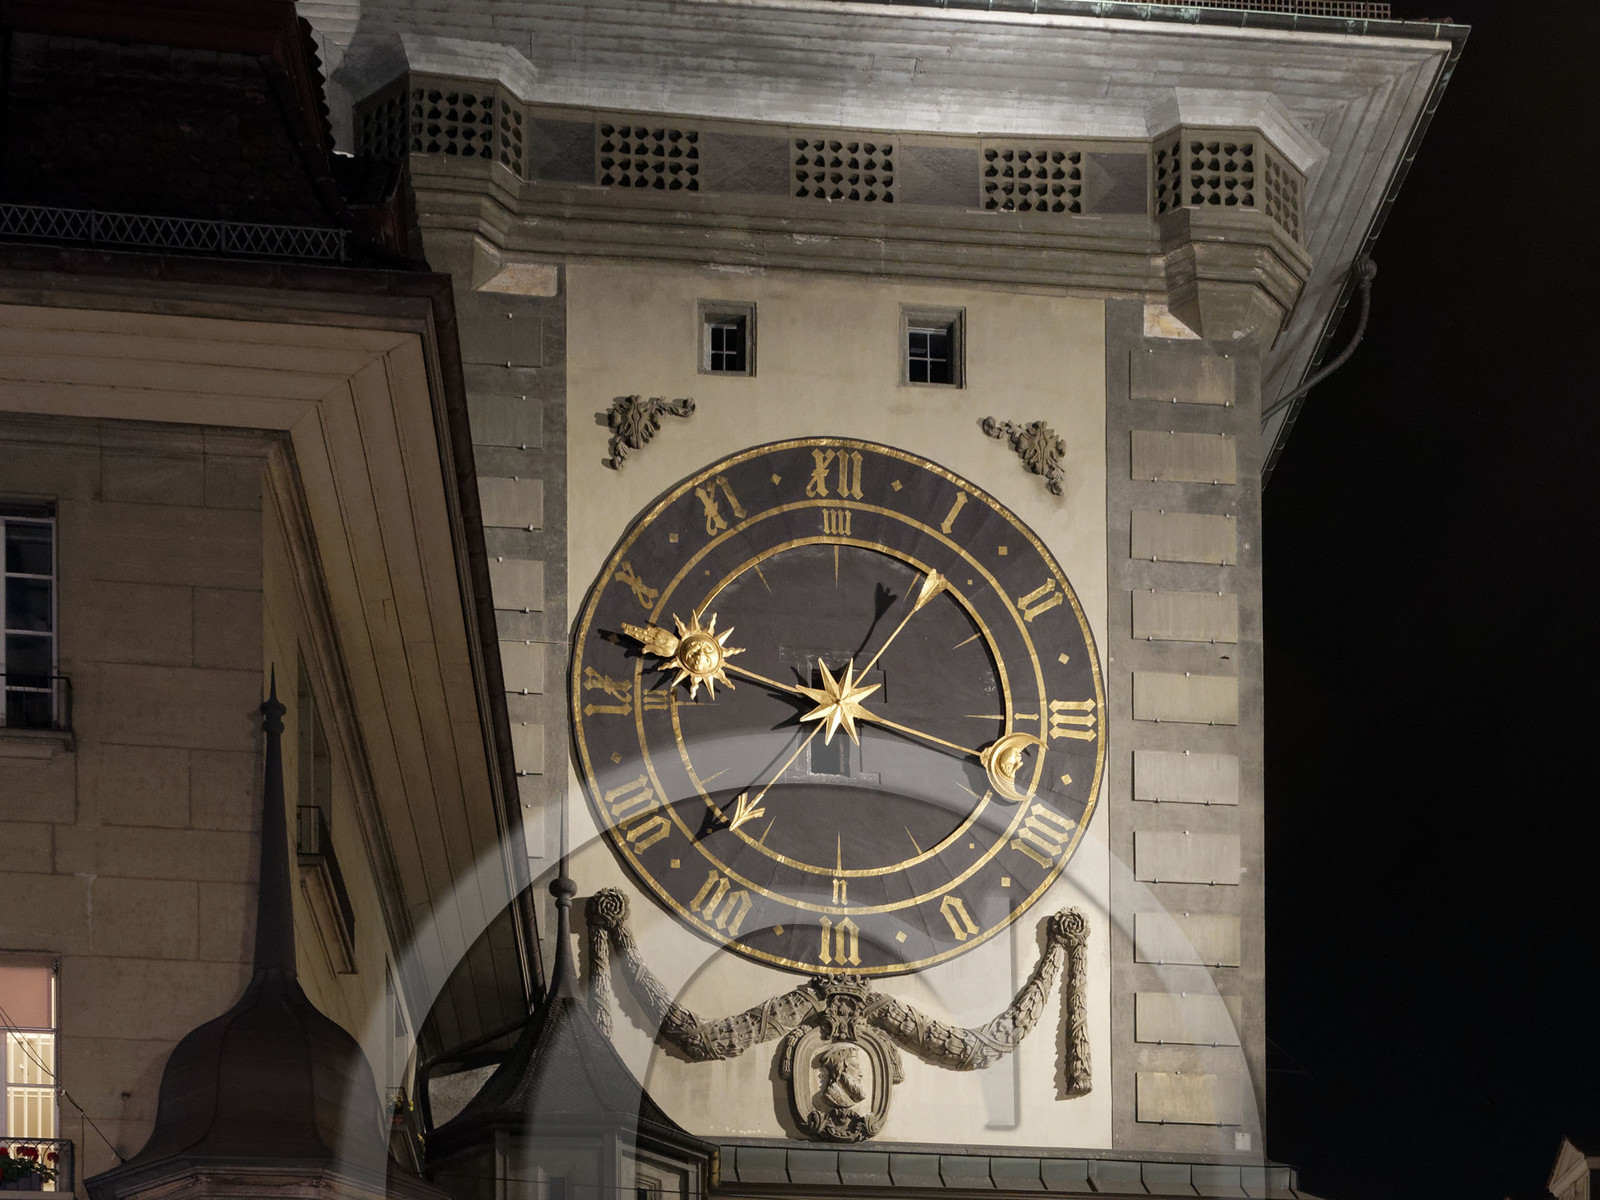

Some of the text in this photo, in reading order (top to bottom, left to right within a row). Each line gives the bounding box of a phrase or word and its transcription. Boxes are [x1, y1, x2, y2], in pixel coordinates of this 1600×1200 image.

[806, 448, 864, 500] XII
[695, 476, 746, 535] XI
[940, 490, 969, 535] I
[1017, 577, 1064, 623] II
[1049, 698, 1097, 743] III
